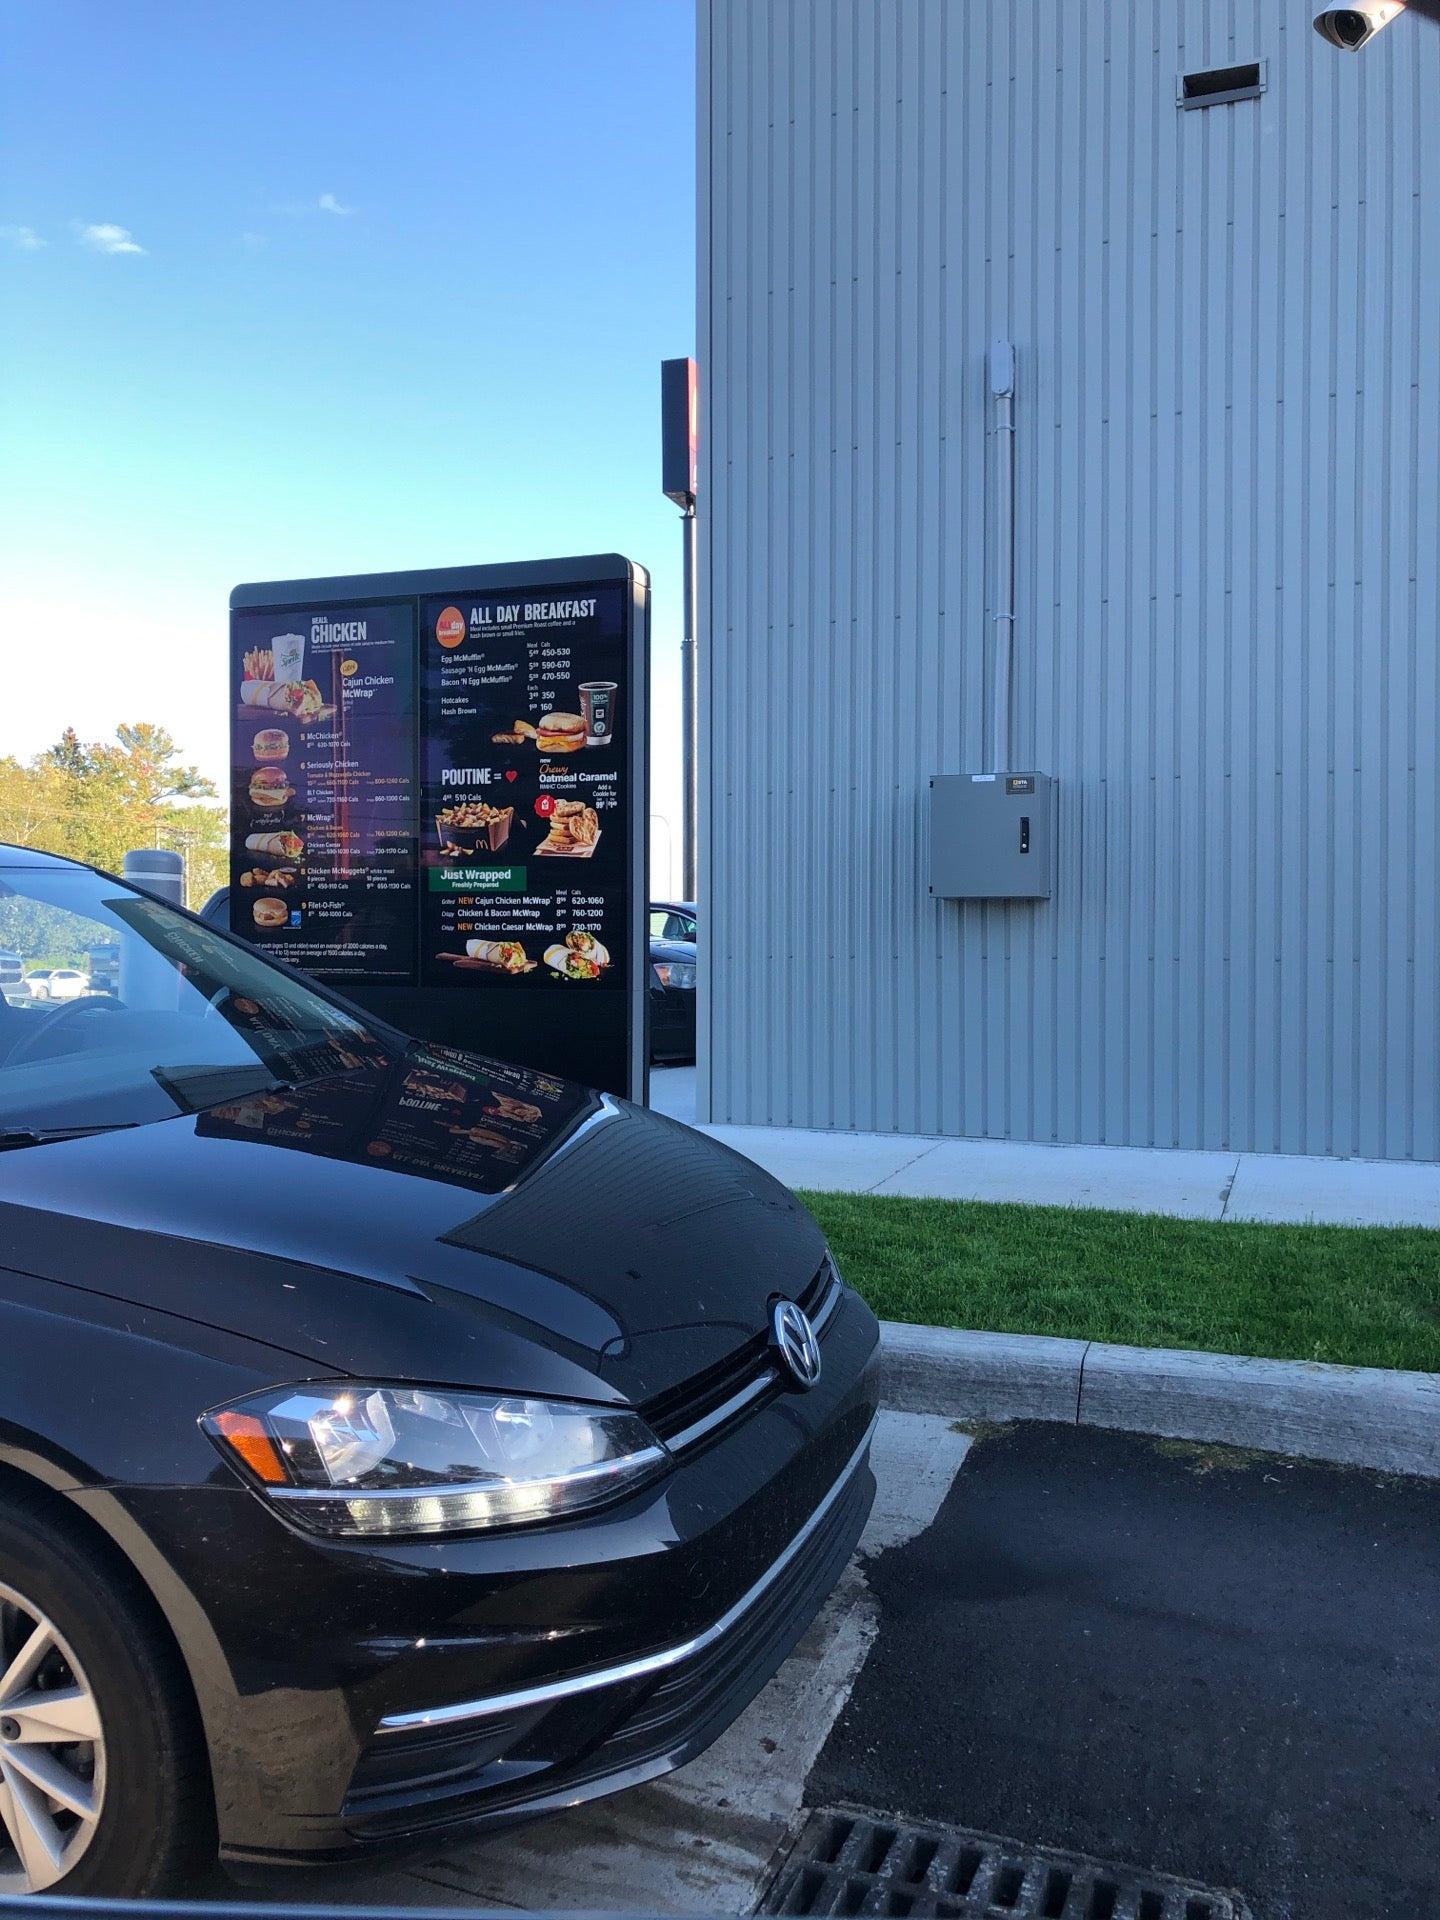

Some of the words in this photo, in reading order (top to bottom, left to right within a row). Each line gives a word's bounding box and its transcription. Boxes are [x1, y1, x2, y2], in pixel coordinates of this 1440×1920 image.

[470, 607, 492, 624] ALL
[497, 605, 520, 622] DAY
[525, 599, 596, 621] BREAKFAST
[311, 622, 367, 644] CHICKEN
[441, 655, 452, 663] Egg
[542, 648, 570, 656] 450-530
[441, 667, 466, 675] Sausage
[542, 661, 570, 669] 590-670
[342, 677, 363, 688] Cajun
[364, 676, 394, 685] Chicken
[468, 677, 480, 686] Egg
[542, 672, 570, 680] 470-550
[300, 762, 305, 770] 6
[307, 761, 333, 770] Seriously
[539, 764, 568, 775] Chewy
[442, 768, 492, 786] POUTINE
[539, 773, 577, 783] Oatmeal
[579, 771, 617, 781] Caramel
[440, 870, 464, 880] Just
[465, 869, 511, 881] Wrapped
[458, 897, 474, 905] NEW
[475, 897, 494, 906] Cajun
[457, 909, 483, 917] Chicken
[490, 909, 511, 917] Bacon
[512, 909, 540, 918] McWrap
[526, 923, 553, 932] McWrap
